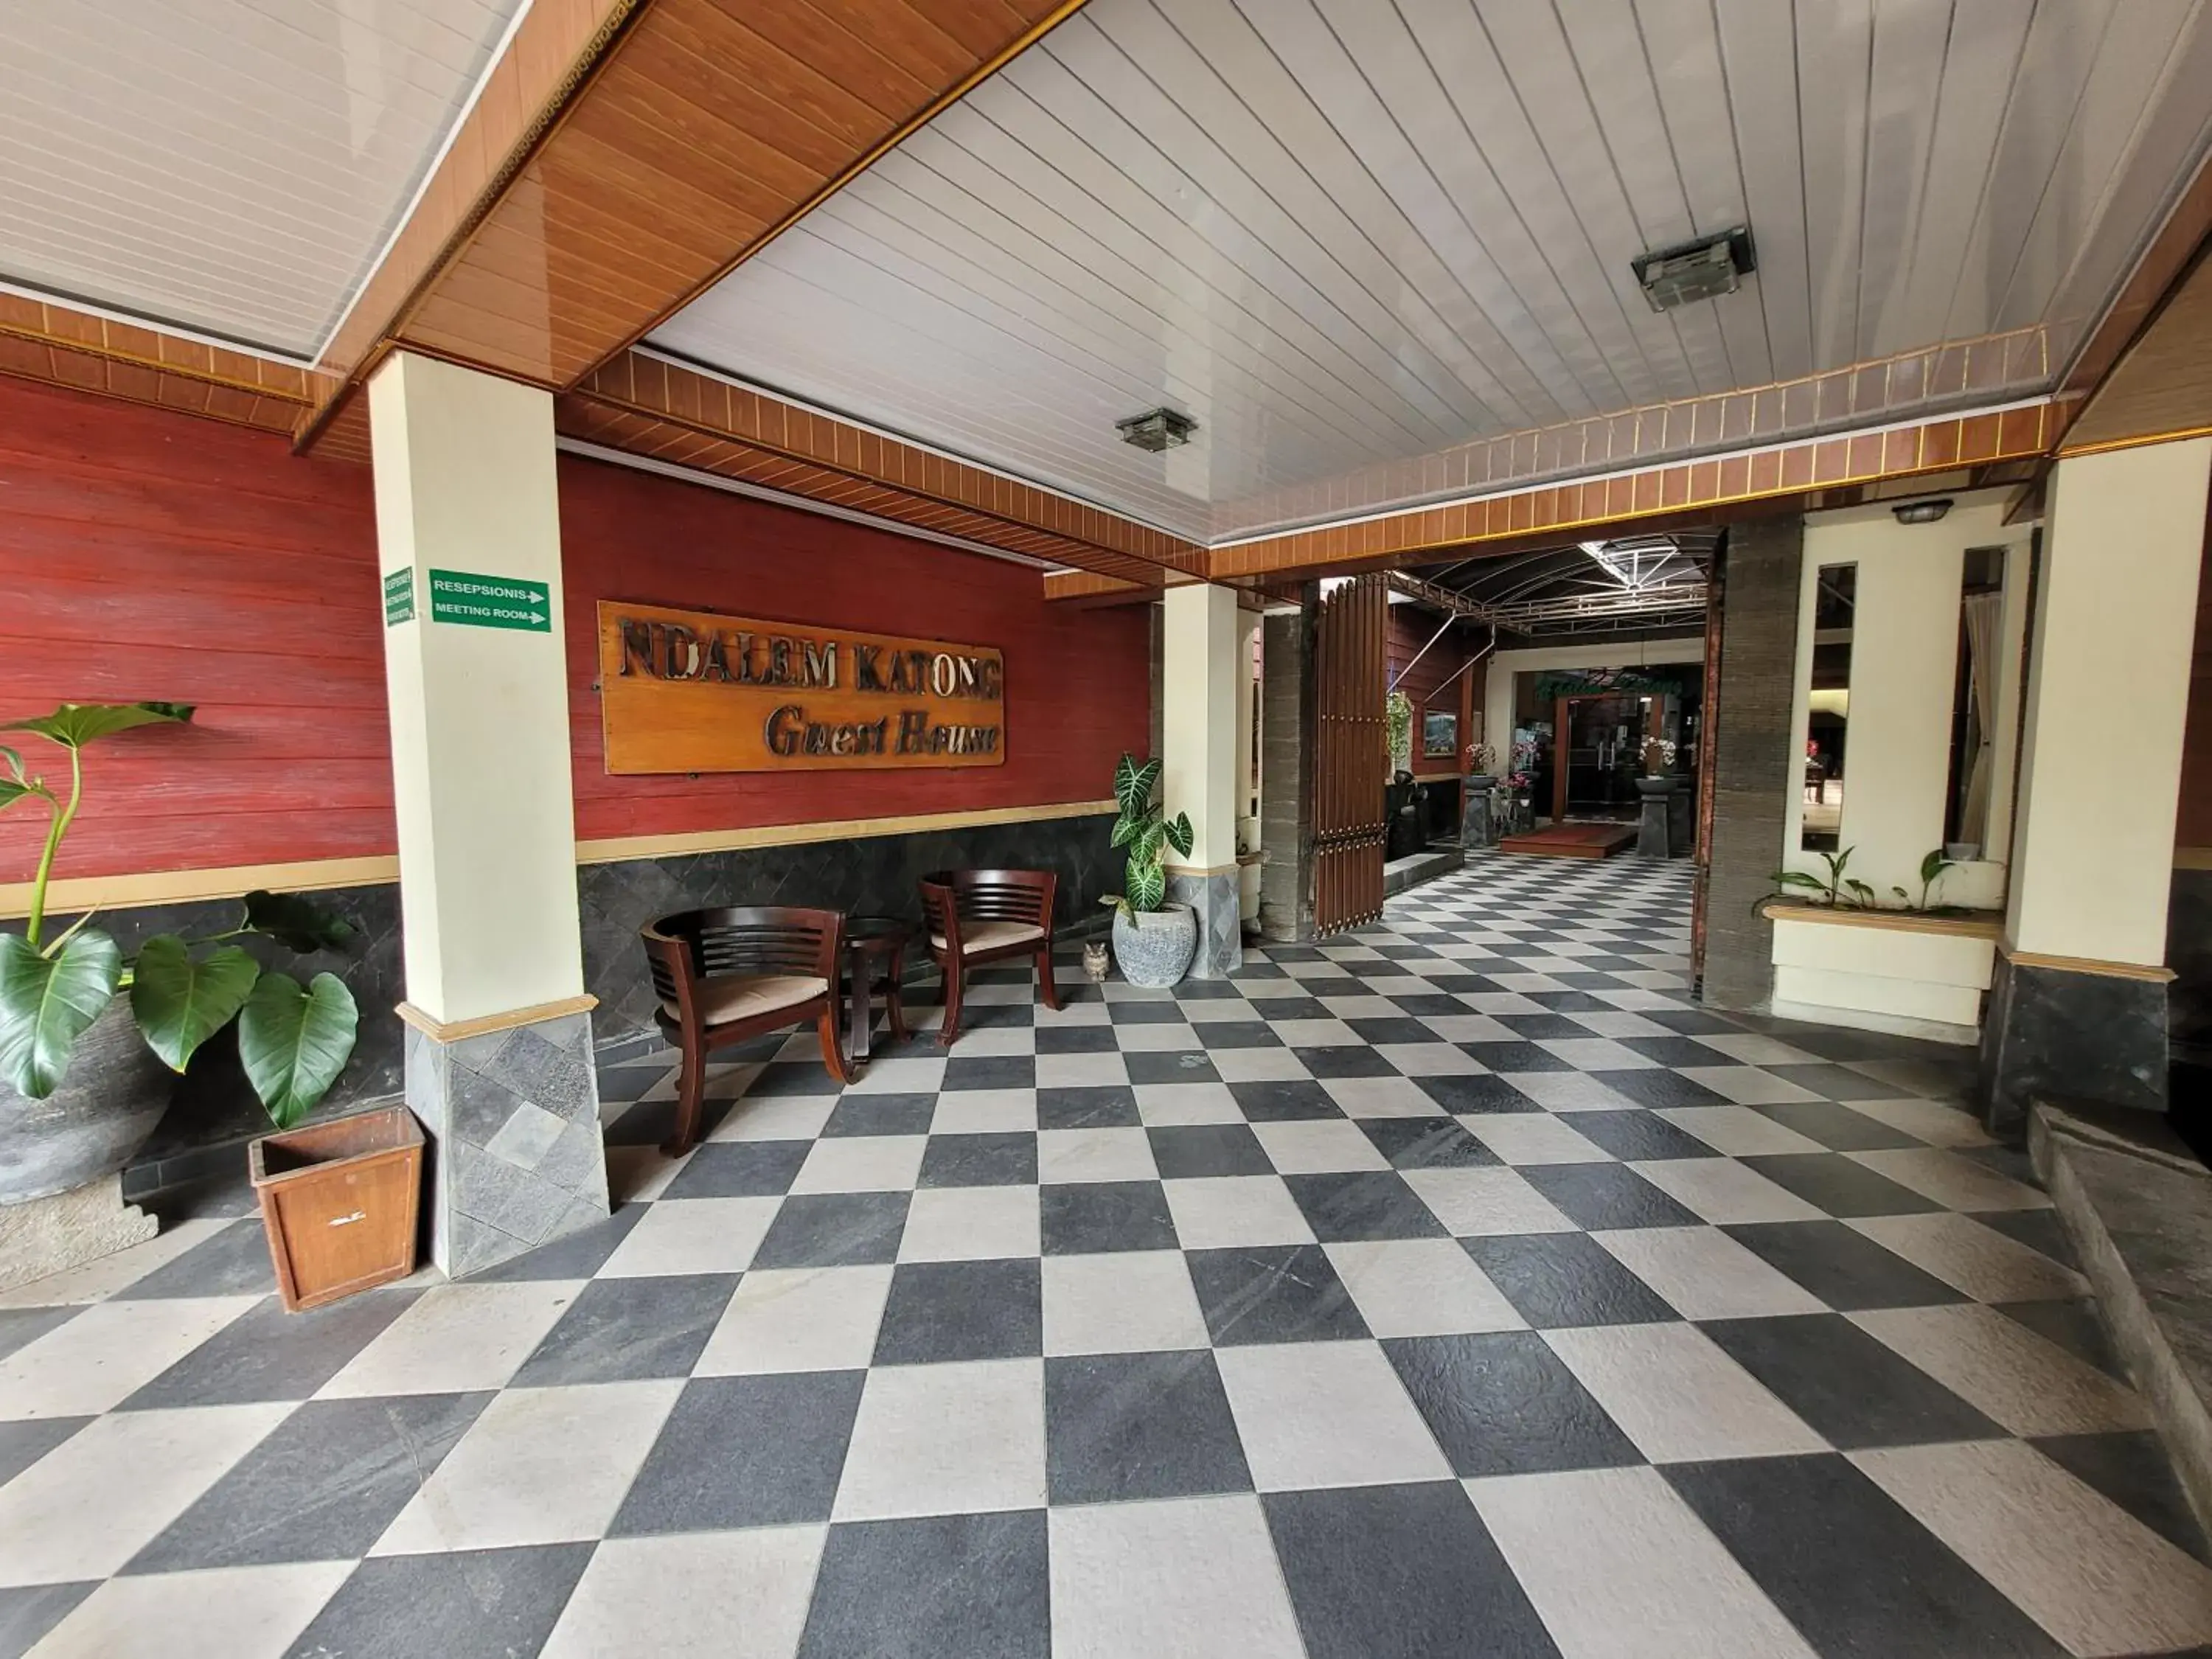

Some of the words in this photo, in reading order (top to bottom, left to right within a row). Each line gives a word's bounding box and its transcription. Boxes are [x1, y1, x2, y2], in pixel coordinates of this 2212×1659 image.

[434, 580, 526, 599] RESEPSIONIS
[436, 603, 490, 616] MEETING
[493, 609, 529, 620] ROOM
[619, 618, 838, 689] NDALEM
[854, 644, 1001, 699] KATONG
[764, 706, 887, 756] Guest
[895, 709, 998, 756] House
